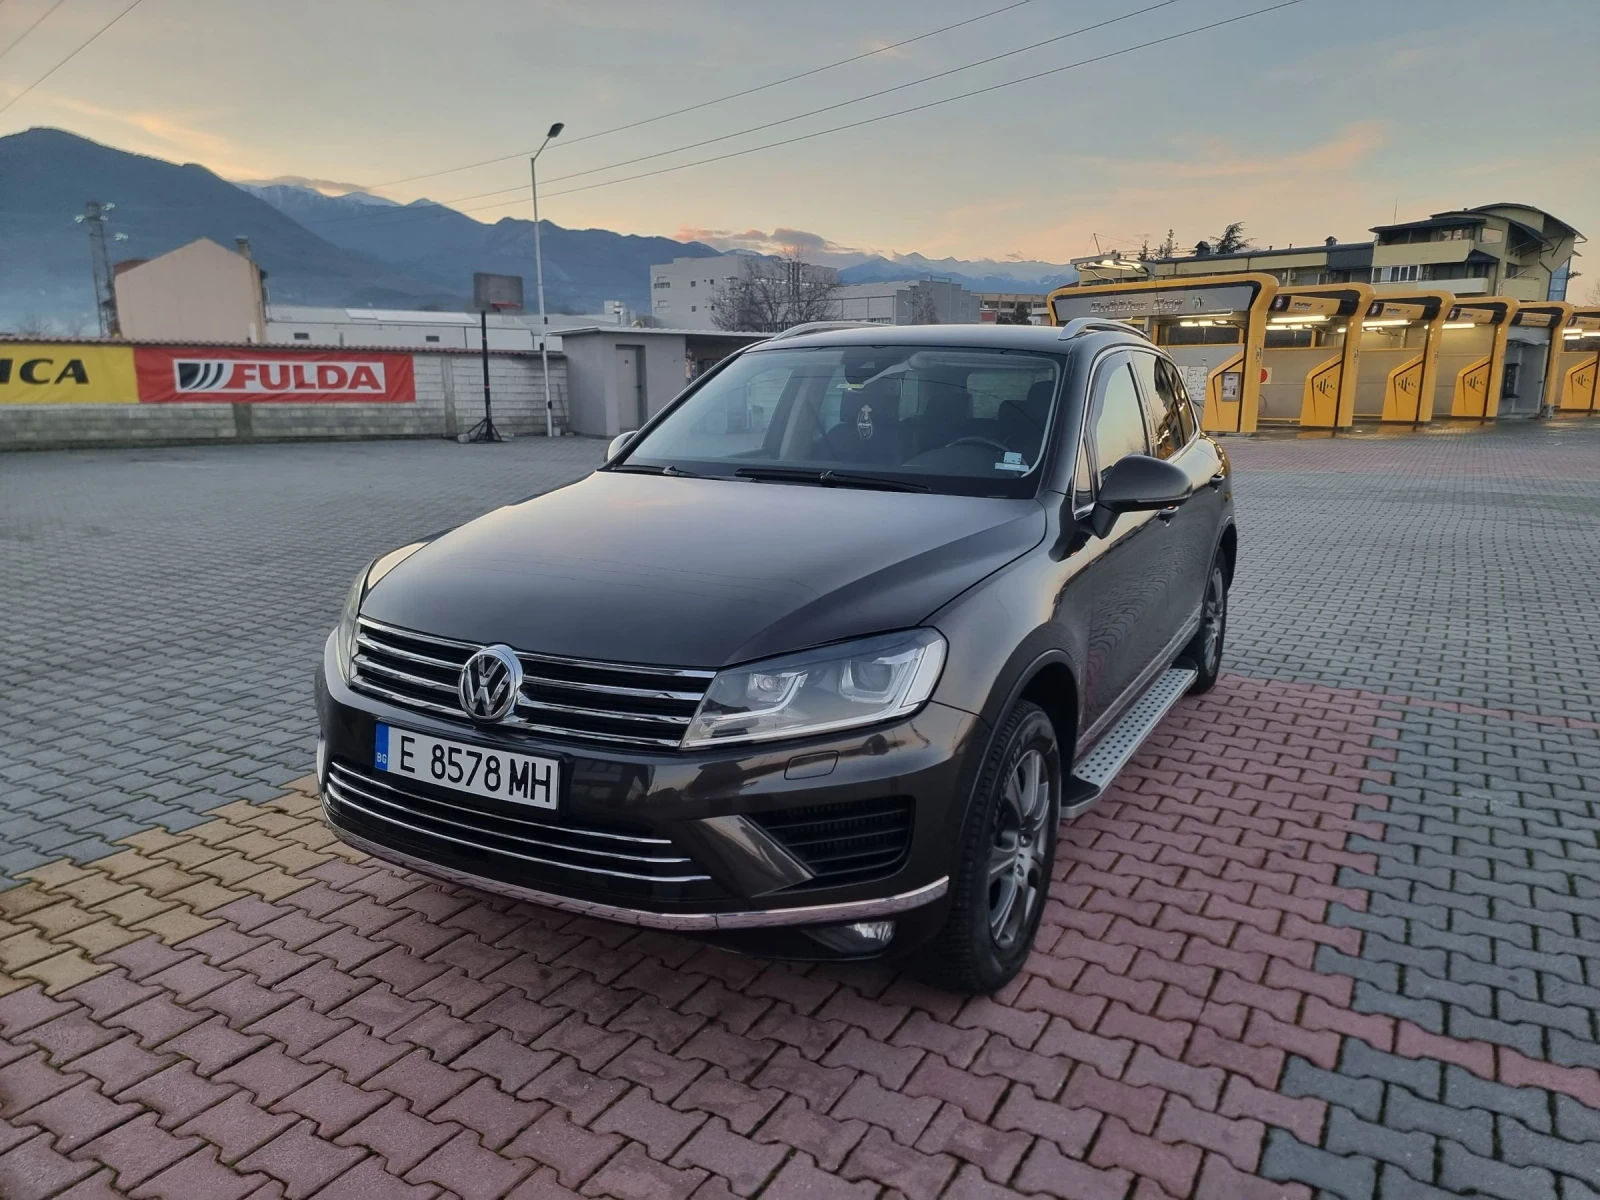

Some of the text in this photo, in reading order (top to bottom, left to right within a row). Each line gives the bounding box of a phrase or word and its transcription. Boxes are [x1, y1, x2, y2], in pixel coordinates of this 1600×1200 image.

[0, 358, 90, 385] ICA
[224, 363, 383, 391] FULDA
[376, 751, 387, 764] BG
[400, 735, 552, 803] E 8578 MH
